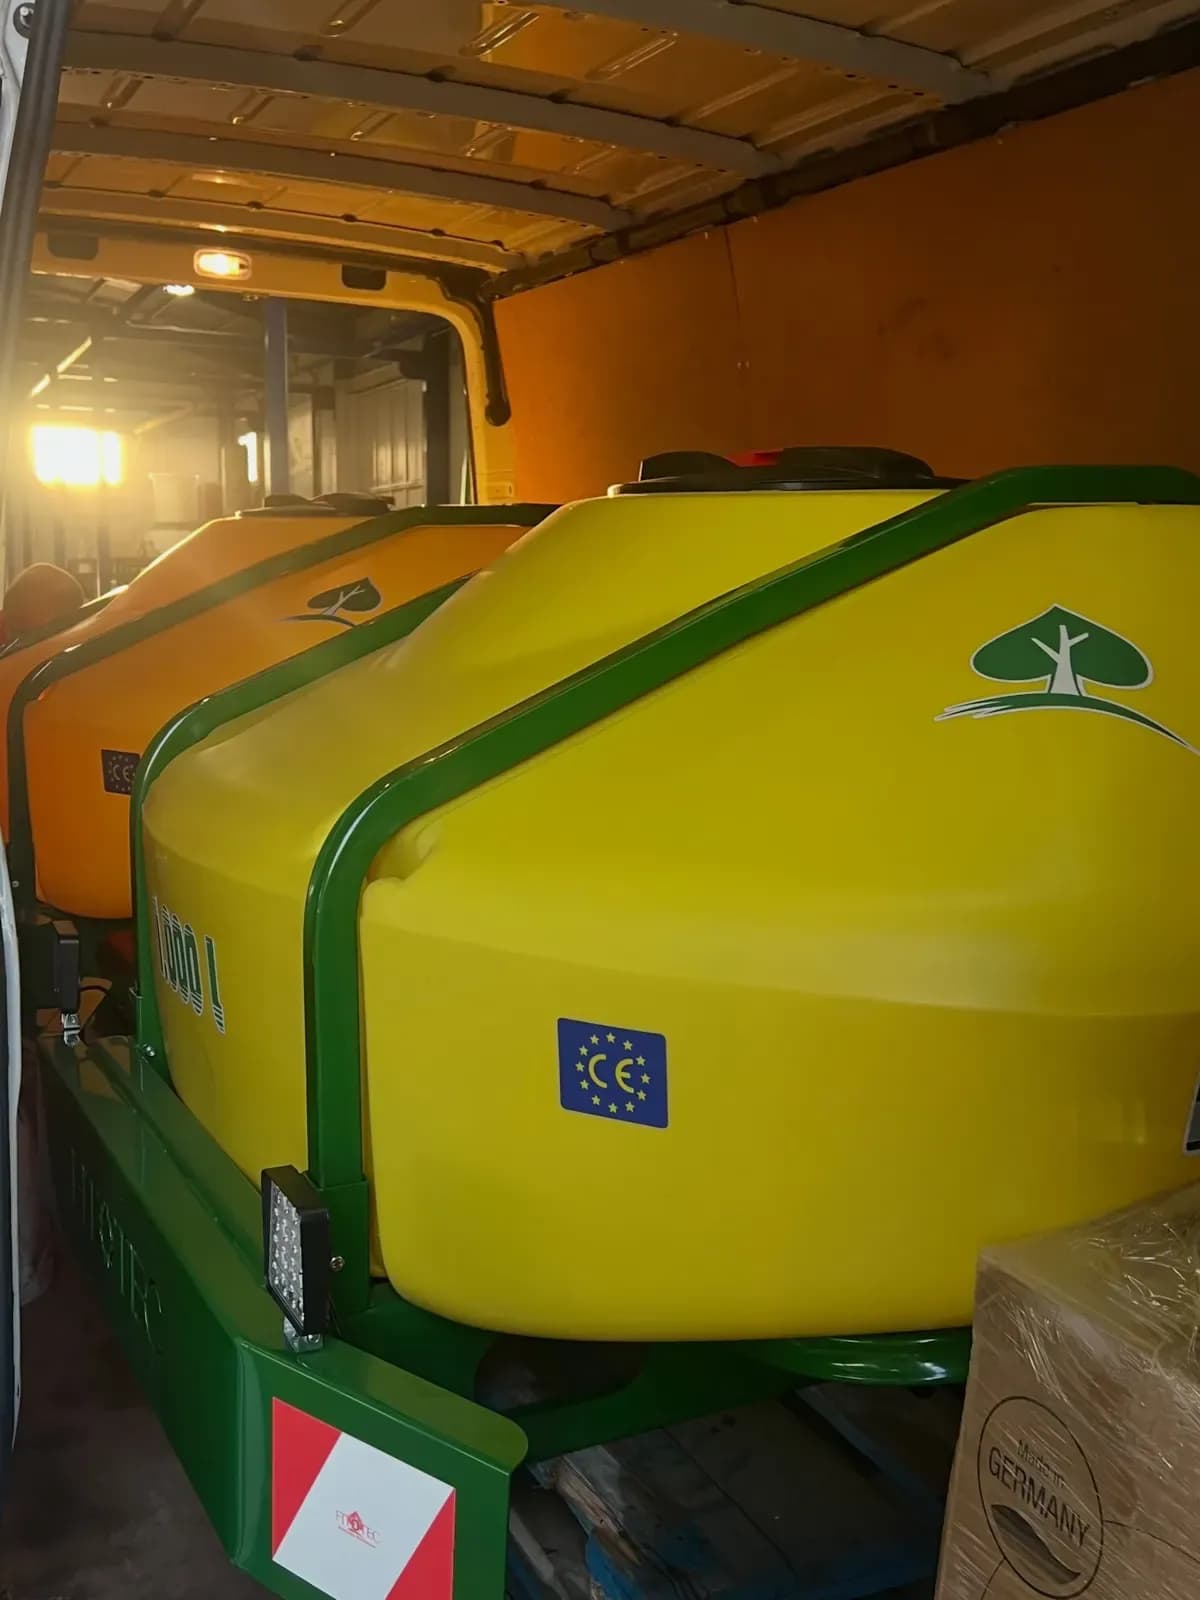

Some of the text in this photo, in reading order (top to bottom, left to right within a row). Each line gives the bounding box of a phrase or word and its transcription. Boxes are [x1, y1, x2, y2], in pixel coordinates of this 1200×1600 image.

[588, 1053, 635, 1094] CE
[1017, 1439, 1051, 1478] Made
[988, 1446, 1091, 1548] GERMANY
